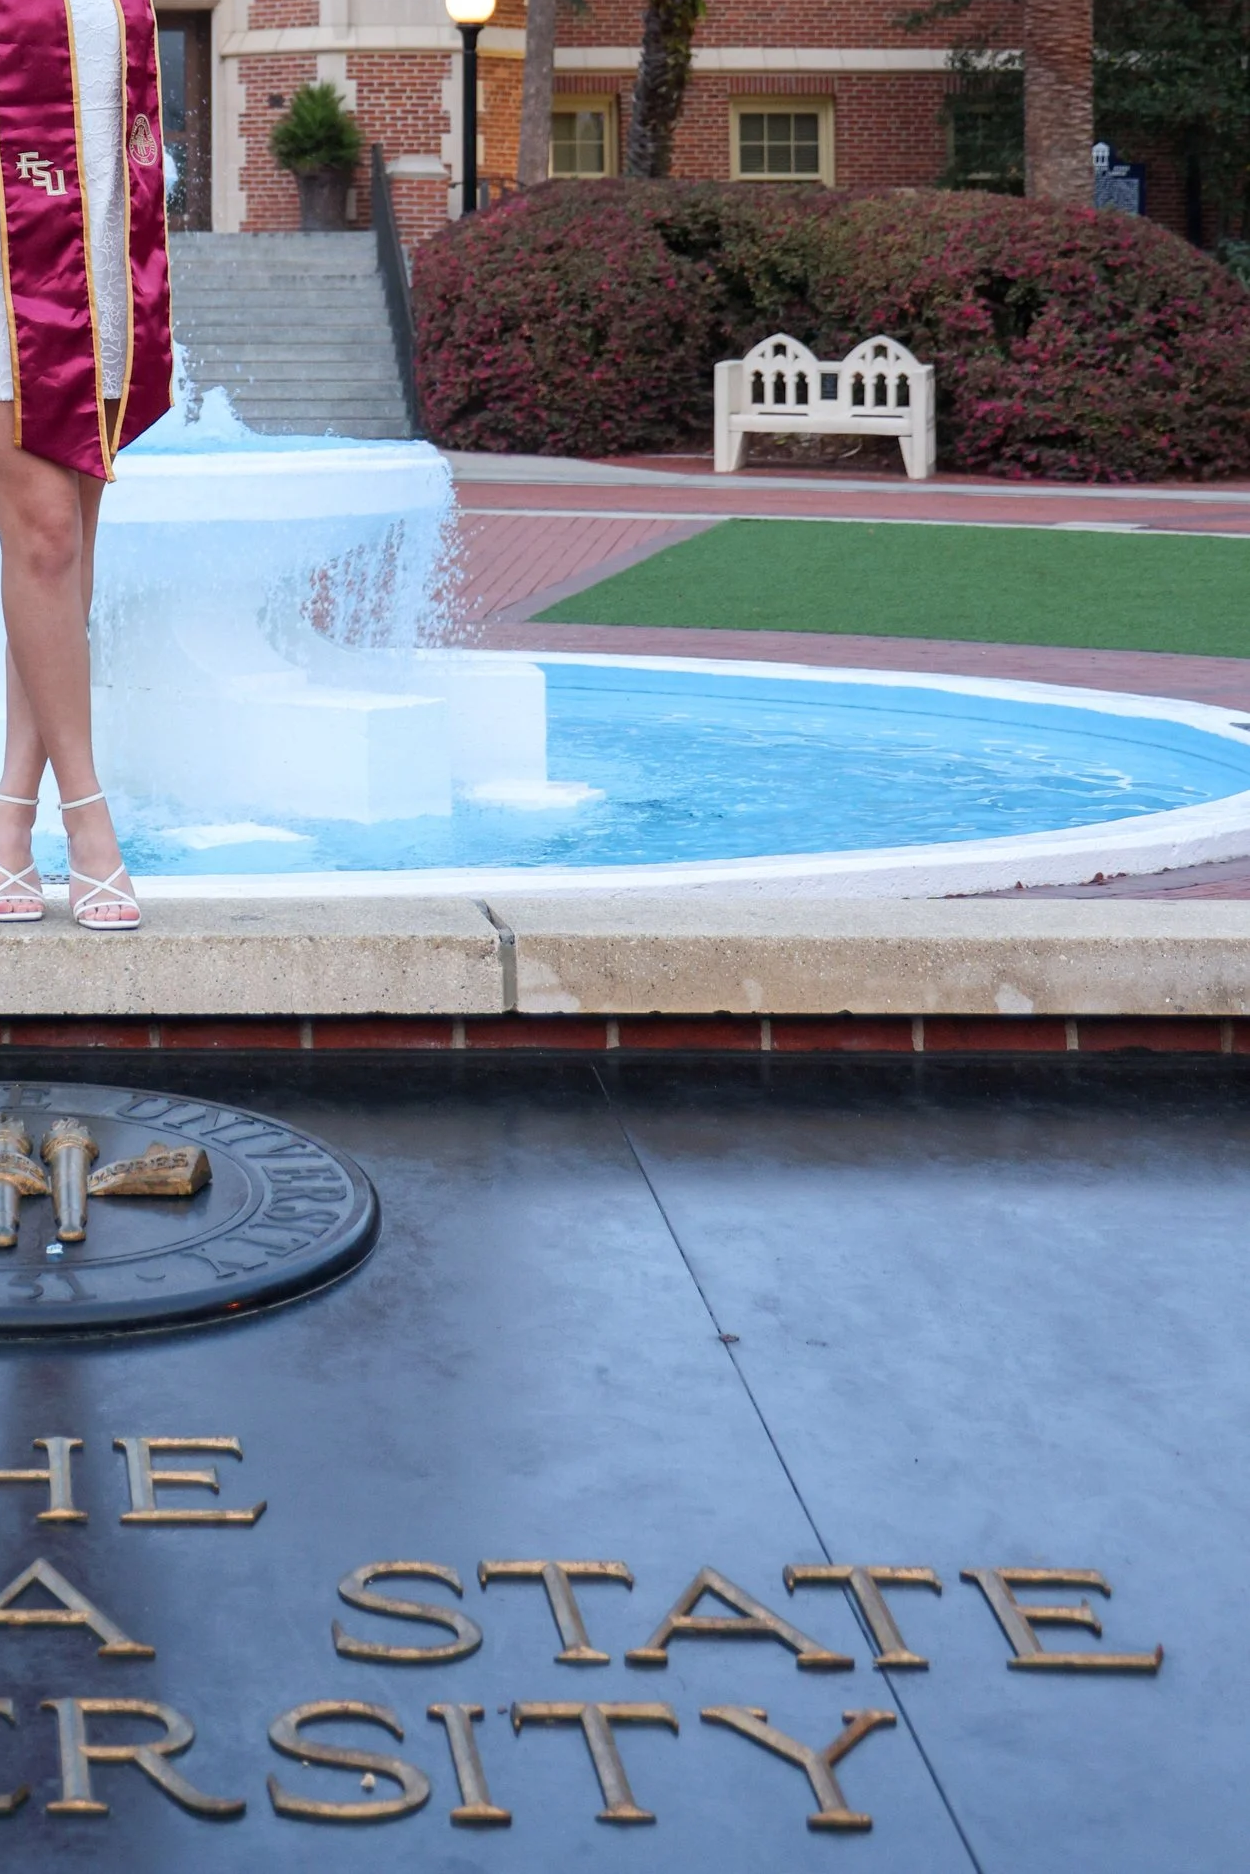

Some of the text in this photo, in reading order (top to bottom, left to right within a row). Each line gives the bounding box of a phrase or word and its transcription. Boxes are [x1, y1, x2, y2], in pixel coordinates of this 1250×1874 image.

[15, 151, 69, 197] FSU
[116, 1093, 347, 1280] UNIVERSITY
[331, 1558, 1164, 1673] STATE
